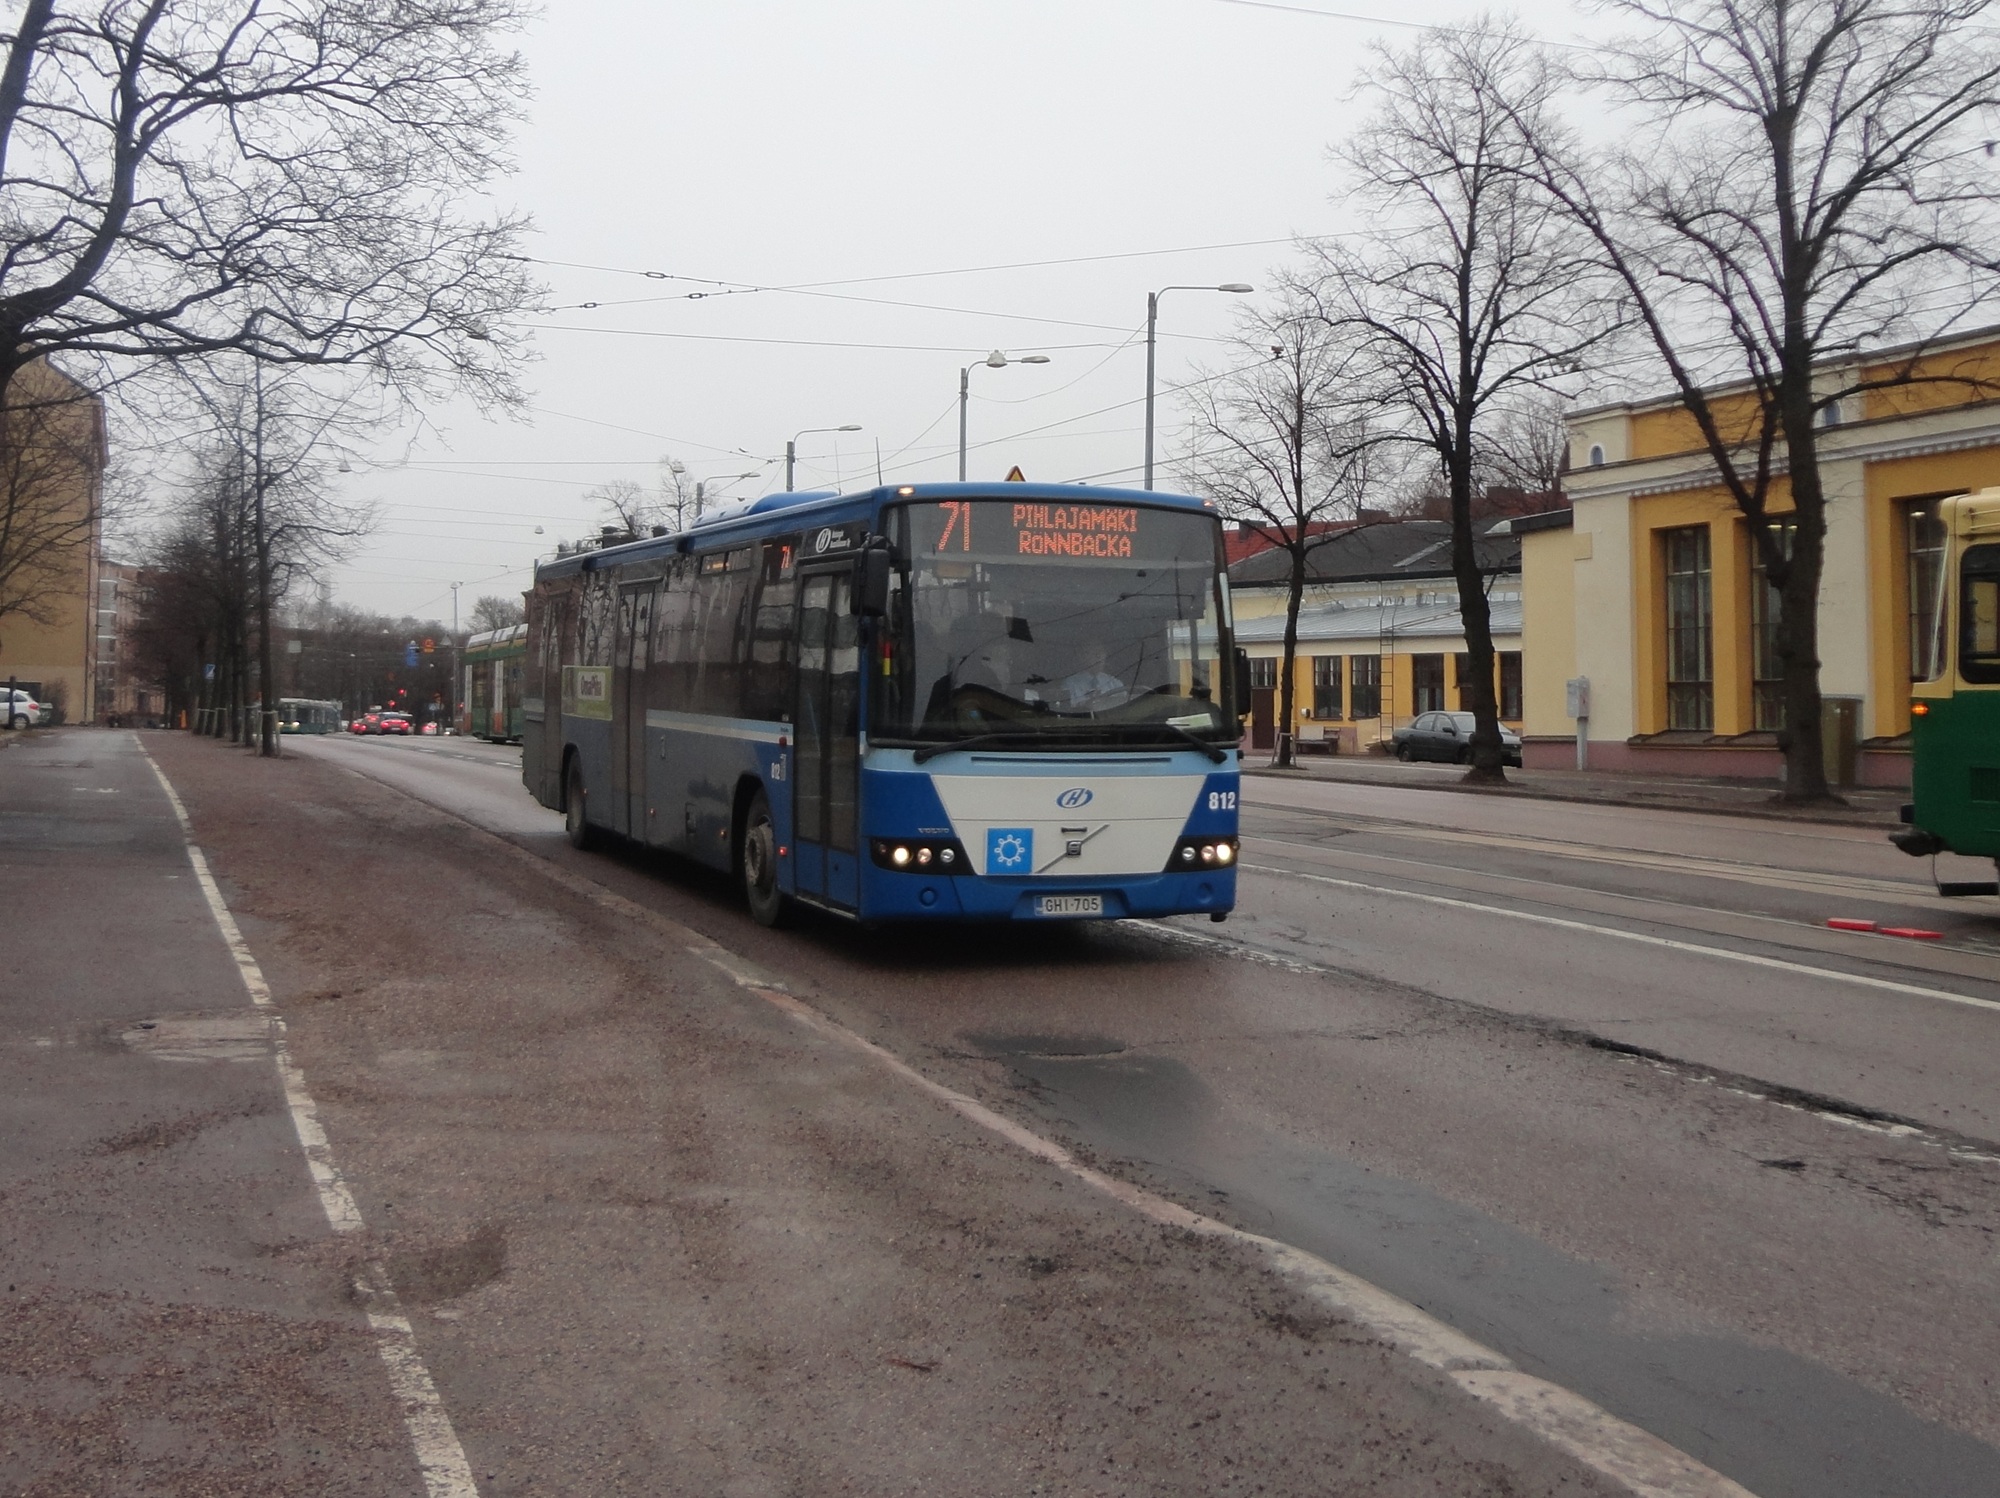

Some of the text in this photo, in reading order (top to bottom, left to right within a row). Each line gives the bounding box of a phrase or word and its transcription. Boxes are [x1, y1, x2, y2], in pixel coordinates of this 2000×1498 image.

[938, 501, 971, 551] 71
[1013, 504, 1137, 532] PIHLAJAMÄKI
[1209, 791, 1236, 810] 812
[1045, 898, 1099, 913] GHI-705
